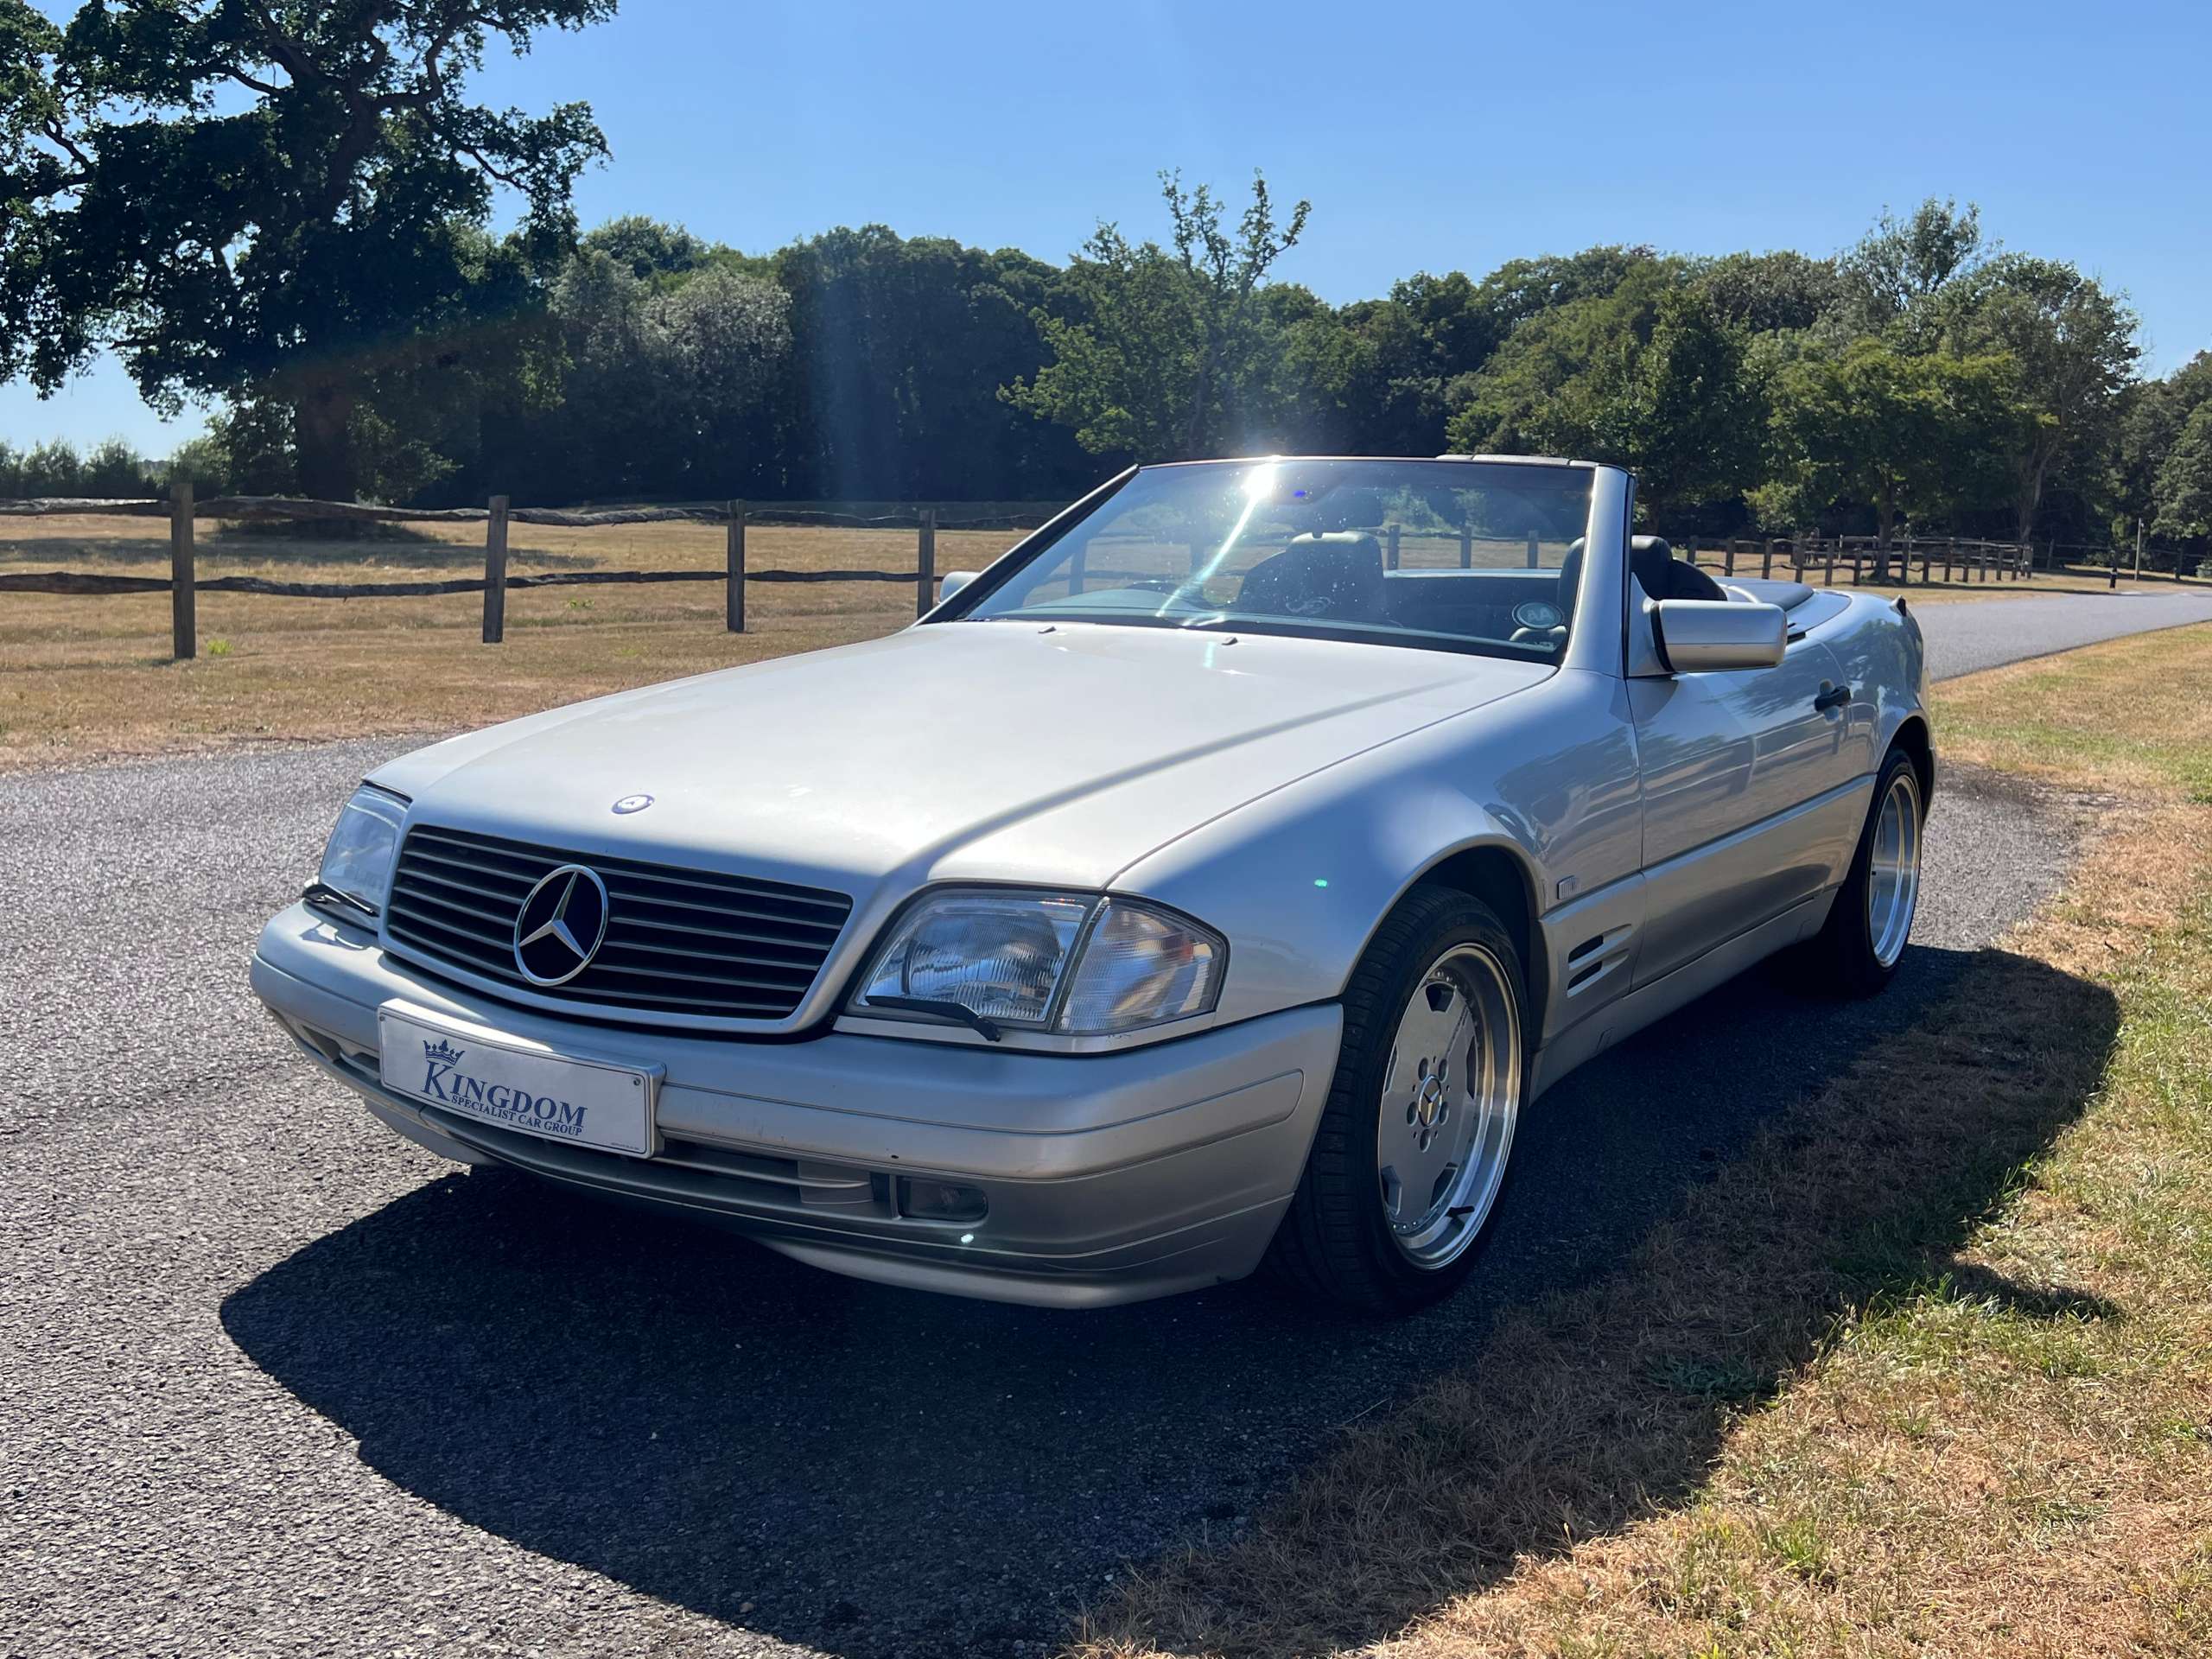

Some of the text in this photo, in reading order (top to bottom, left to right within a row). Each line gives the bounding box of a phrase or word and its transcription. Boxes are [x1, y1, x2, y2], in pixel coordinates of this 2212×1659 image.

[420, 1061, 588, 1128] KINGDOM
[451, 1095, 583, 1136] SPECIALIST CAR GROUP
